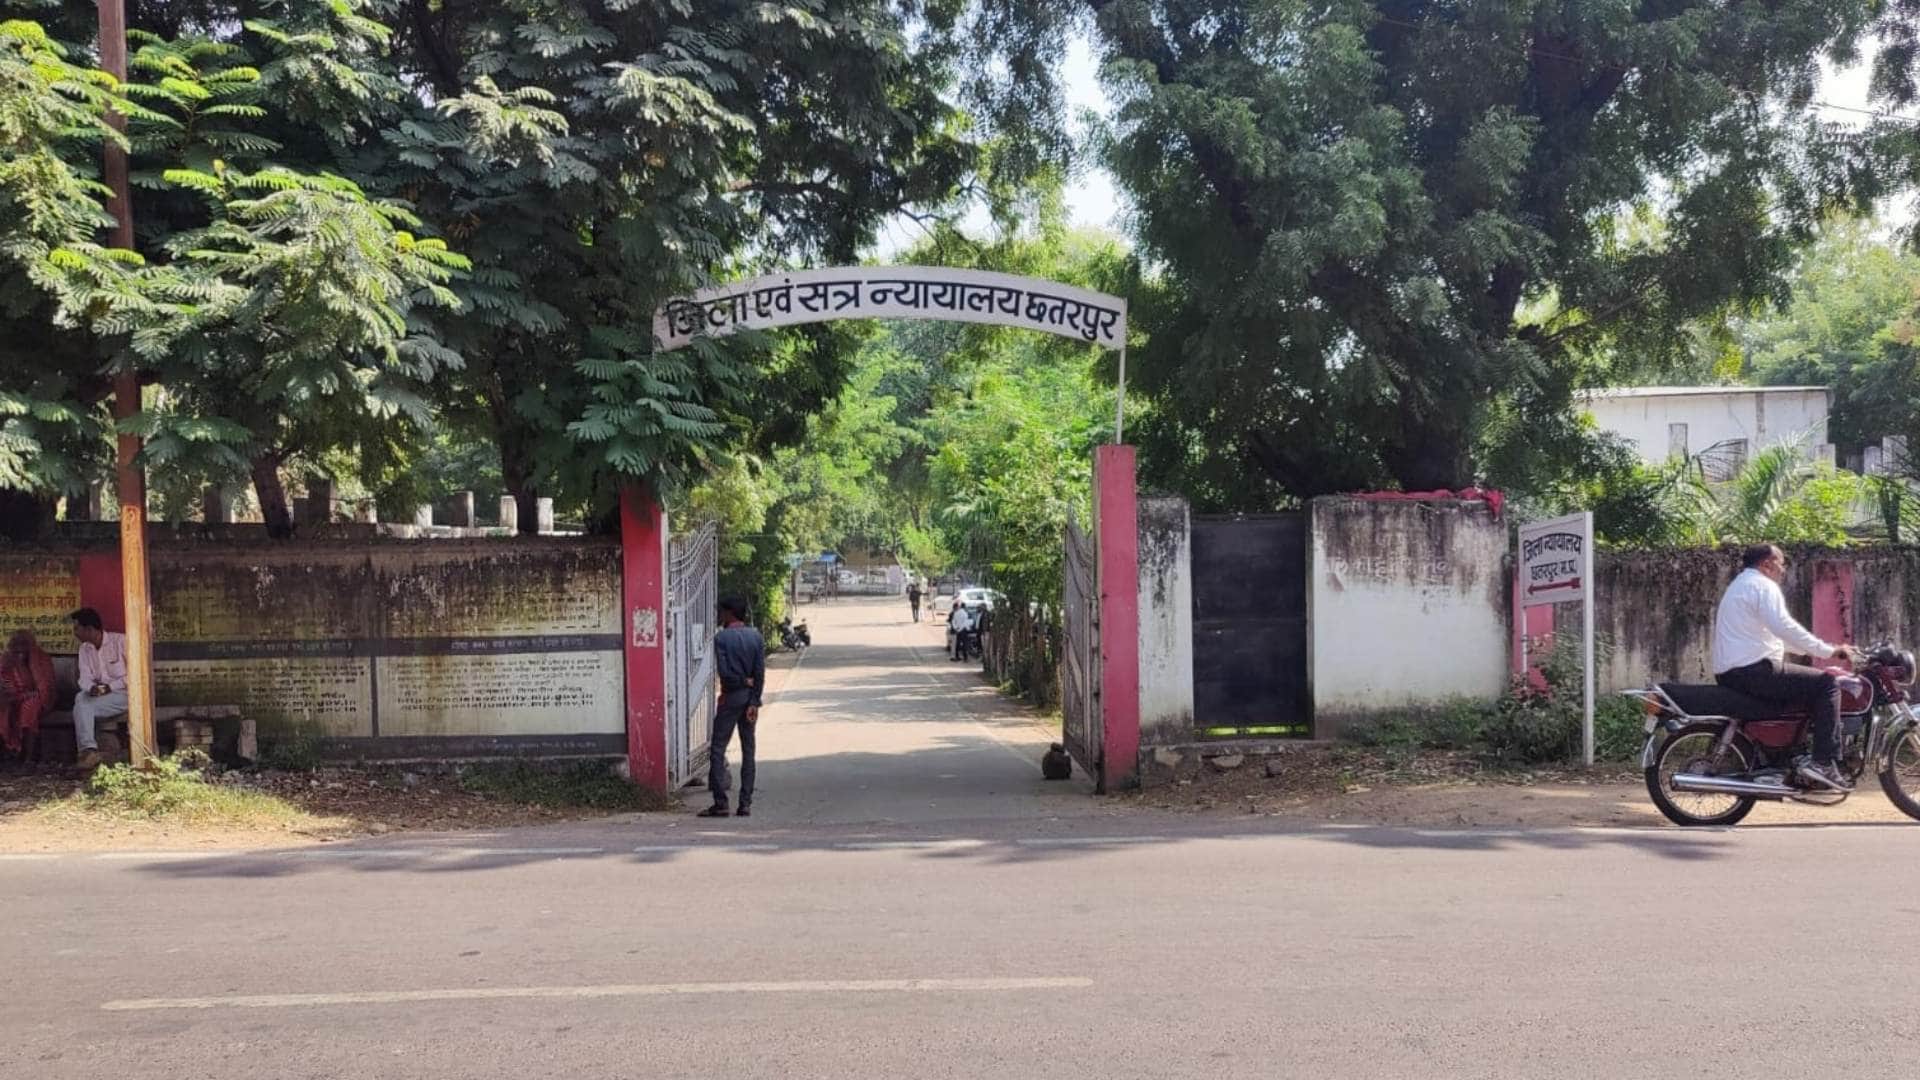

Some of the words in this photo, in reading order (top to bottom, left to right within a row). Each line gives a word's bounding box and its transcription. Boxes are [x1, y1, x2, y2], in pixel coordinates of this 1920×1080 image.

[752, 278, 794, 319] एवं
[797, 280, 862, 312] सत्र
[867, 279, 1023, 316] न्यायालय
[1025, 291, 1121, 341] छतरपुर
